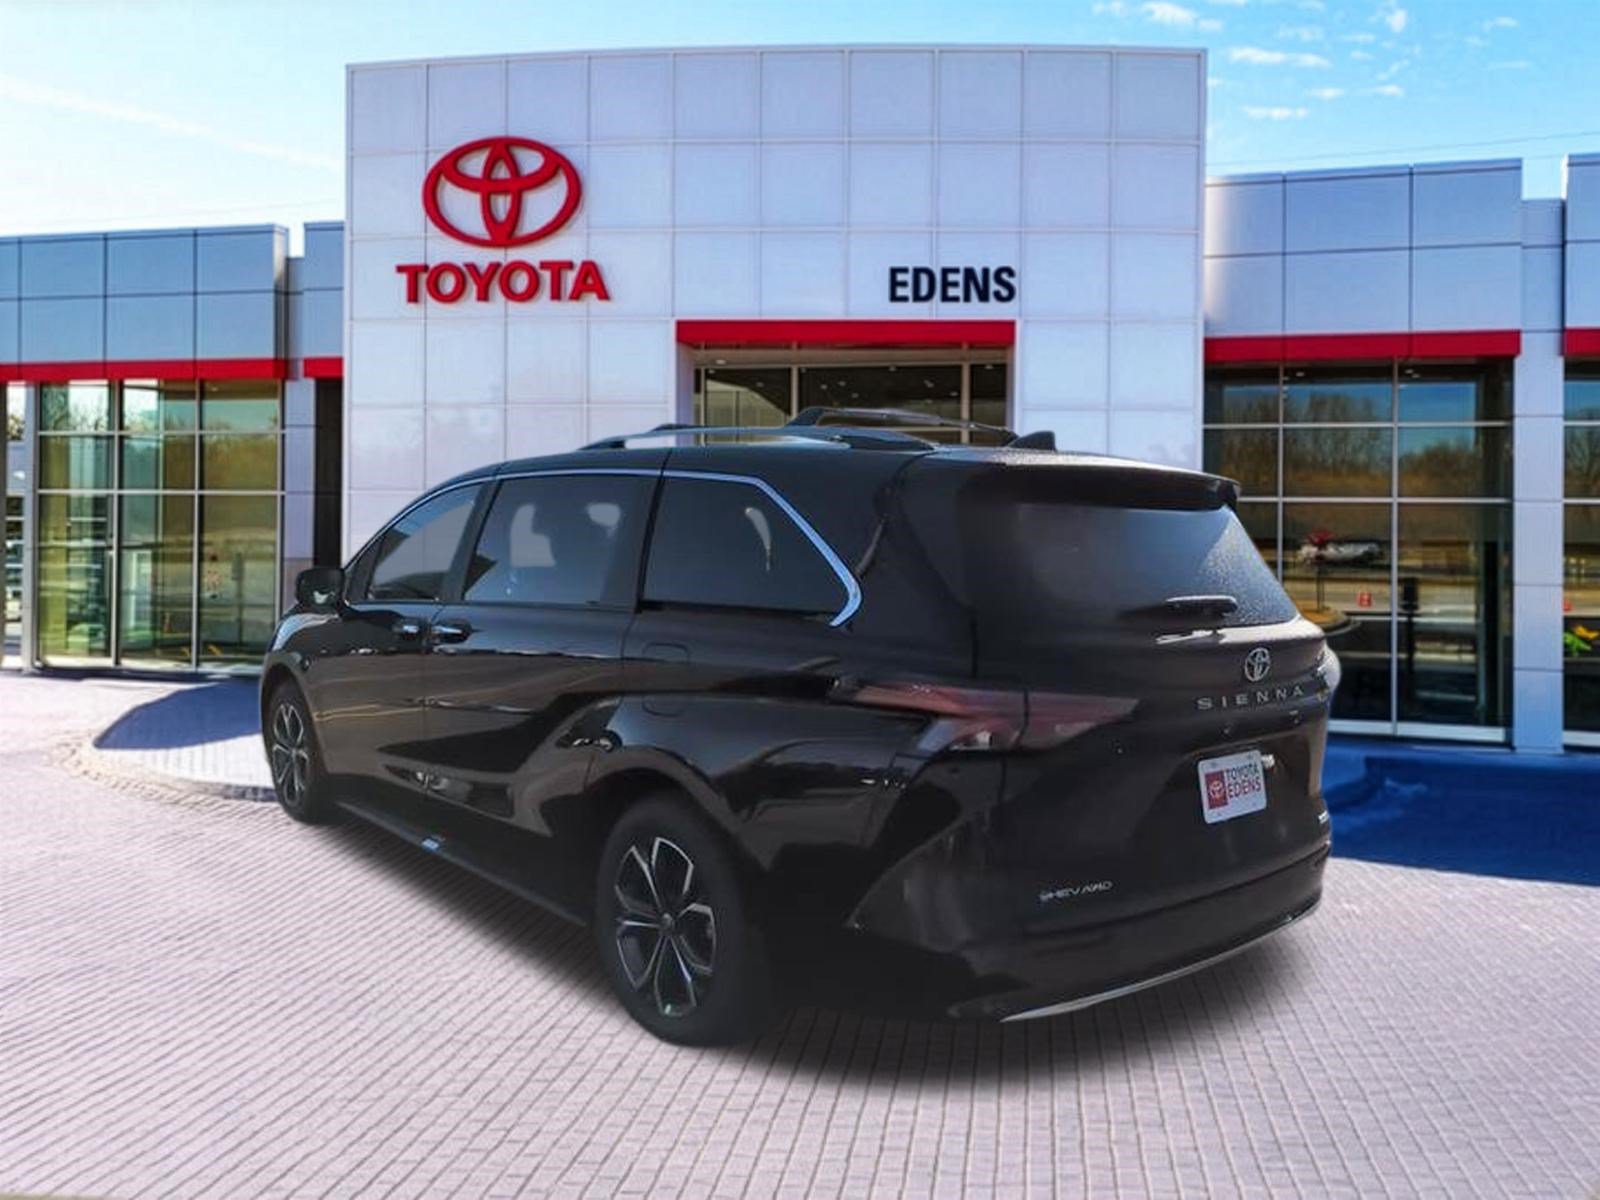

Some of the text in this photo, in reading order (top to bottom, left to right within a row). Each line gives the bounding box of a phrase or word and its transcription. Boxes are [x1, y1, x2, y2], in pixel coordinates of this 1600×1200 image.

[396, 260, 611, 304] TOYOTA
[889, 266, 1016, 303] EDENS
[1197, 685, 1303, 710] SIENNA
[1226, 764, 1260, 782] TOYOTA
[1228, 777, 1262, 798] EDENS
